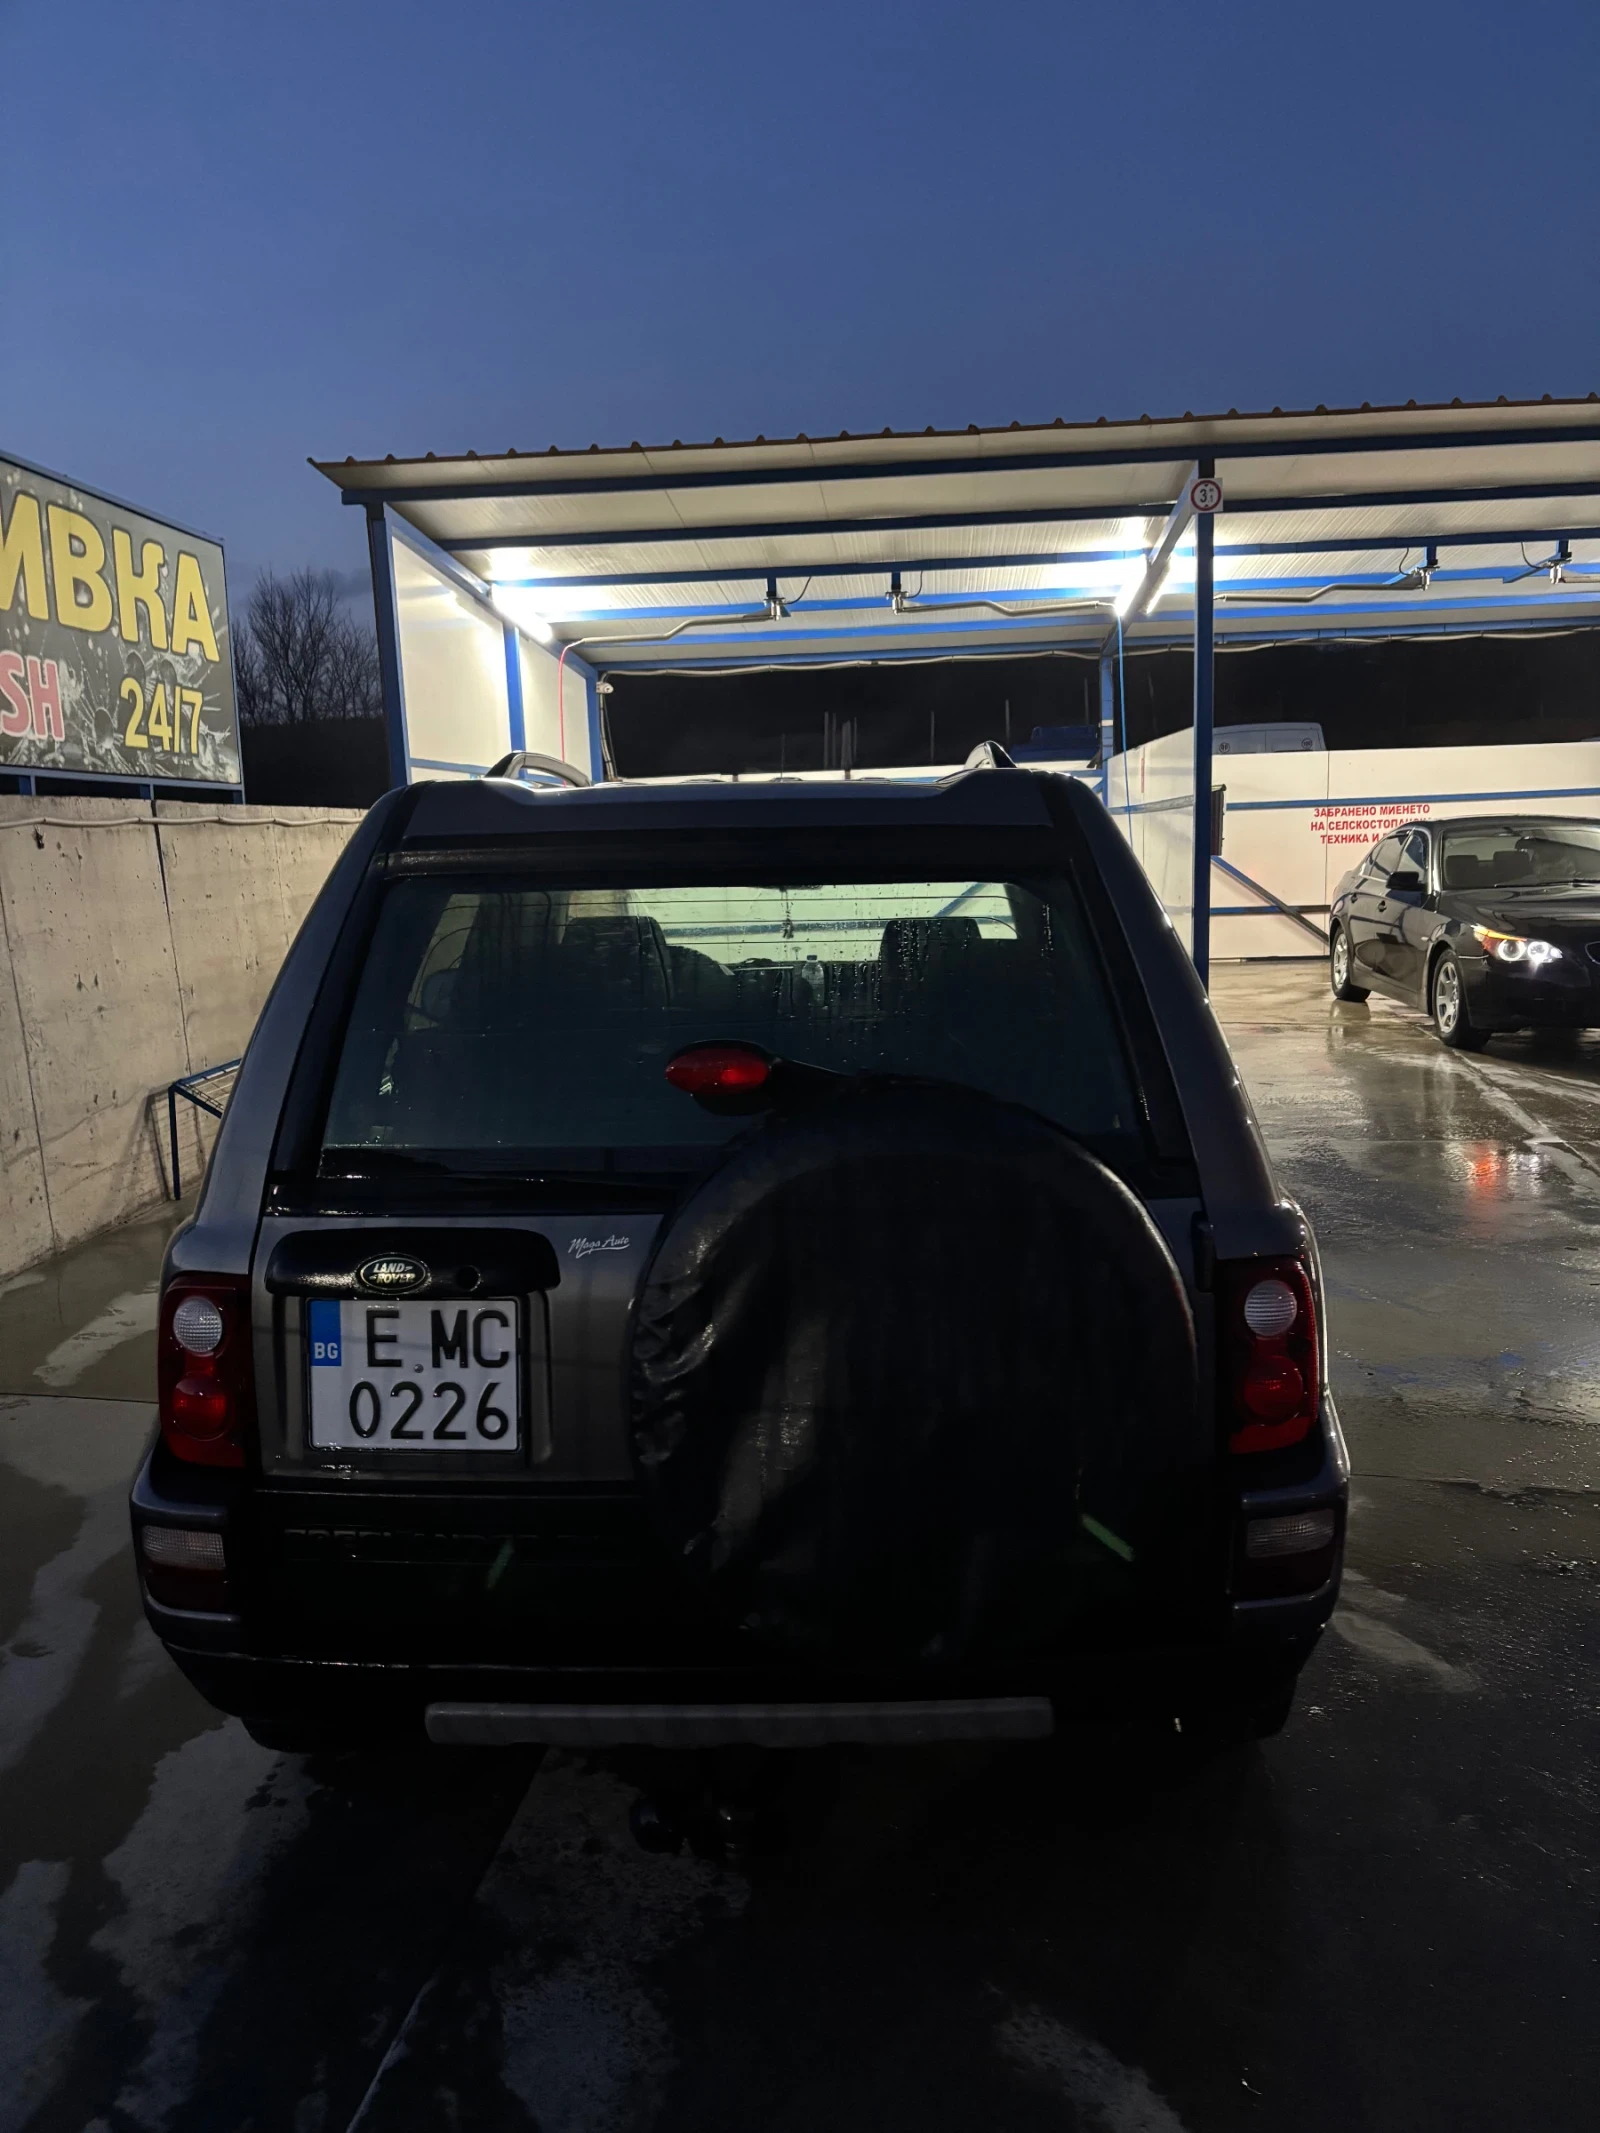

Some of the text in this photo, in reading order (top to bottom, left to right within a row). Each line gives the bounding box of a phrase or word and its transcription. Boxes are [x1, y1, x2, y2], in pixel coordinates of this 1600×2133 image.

[1314, 804, 1430, 818] ЗАБРАНЕНО МИЕНЕТО
[1310, 822, 1326, 832] НА
[1320, 834, 1369, 845] ТЕХНИКА
[1371, 833, 1380, 843] И
[373, 1262, 405, 1273] LAND
[376, 1272, 416, 1285] ROVER
[366, 1309, 510, 1369] E MC
[313, 1342, 339, 1360] BG
[349, 1381, 510, 1440] 0226
